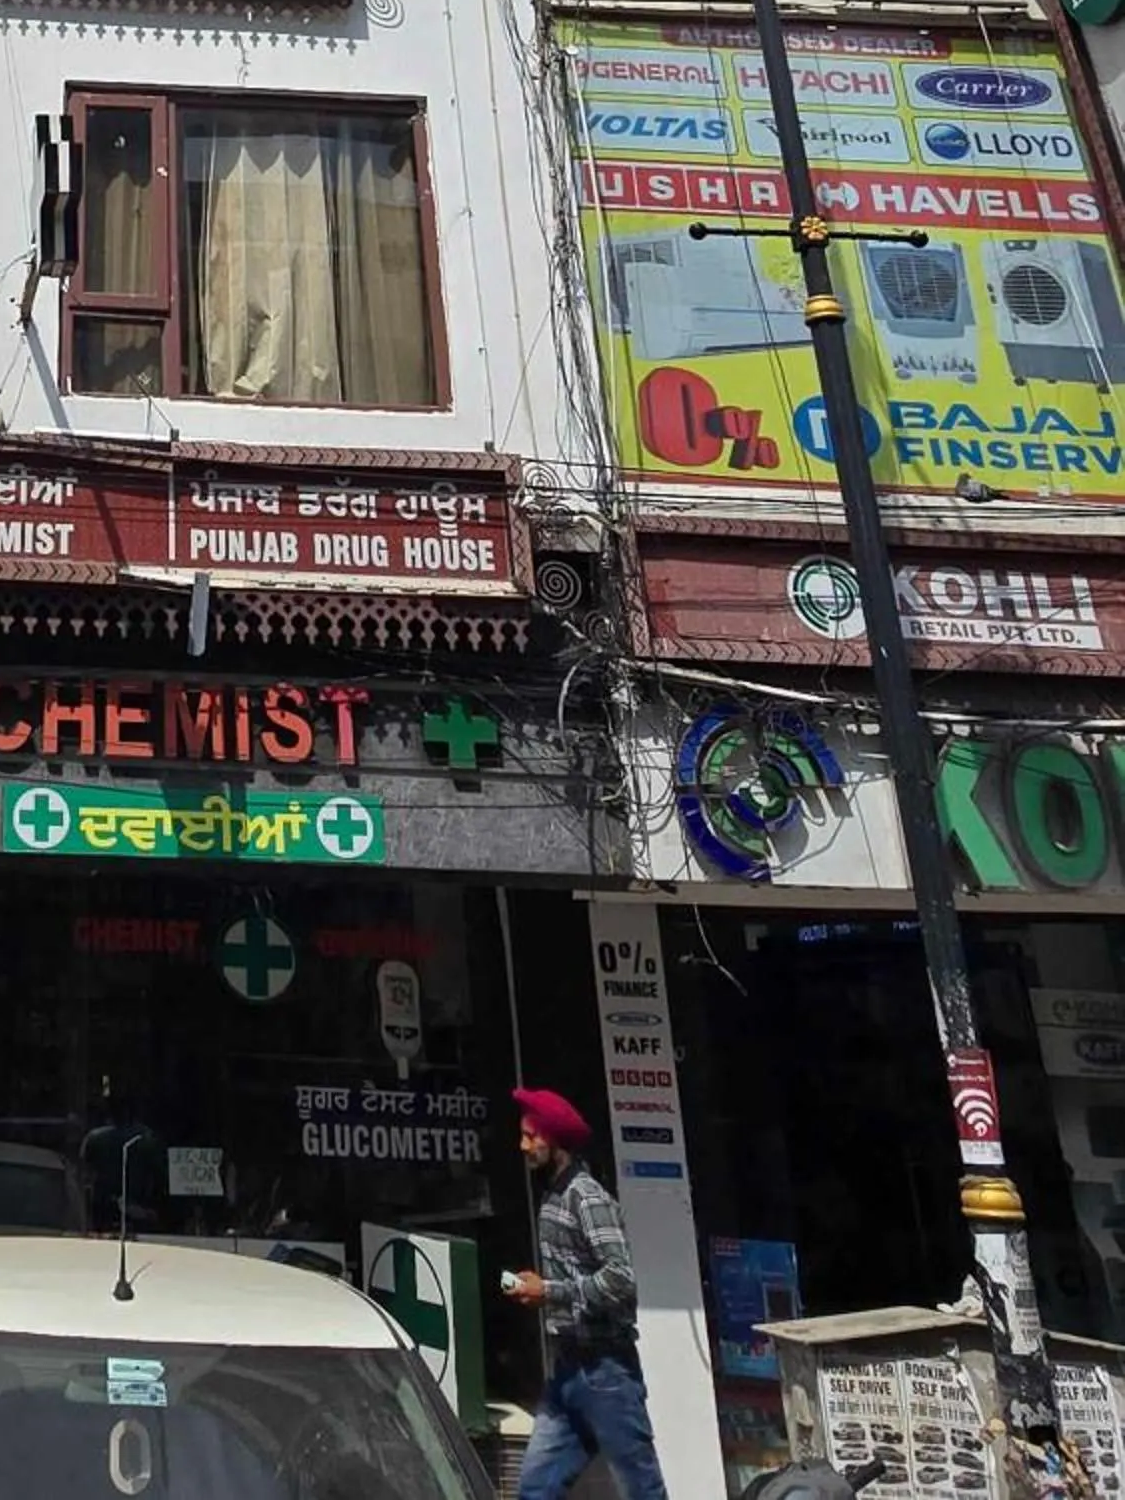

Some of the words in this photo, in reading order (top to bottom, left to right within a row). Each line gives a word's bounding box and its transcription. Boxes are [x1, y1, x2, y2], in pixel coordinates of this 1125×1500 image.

[842, 35, 938, 56] DEALER
[936, 75, 1034, 98] Carrier
[580, 112, 728, 141] VOLTAS
[975, 132, 1074, 158] LLOYD
[598, 171, 780, 207] USHA
[871, 183, 1101, 223] HAVELLS
[888, 401, 1117, 439] BAJAJ
[893, 436, 1124, 475] FINSERV
[189, 471, 282, 515] ਪੰਜਾਬ
[190, 528, 299, 564] PUNJAB
[313, 533, 389, 568] DRUG
[403, 536, 496, 572] HOUSE
[889, 563, 1097, 622] KOHLI
[910, 620, 982, 639] RETAIL
[988, 624, 1032, 641] PVT.
[1038, 630, 1082, 645] LTD.
[597, 941, 657, 975] 0%
[603, 980, 659, 999] FINANCE
[613, 1036, 662, 1056] KAFF
[301, 1120, 483, 1163] GLUCOMETER
[830, 1378, 855, 1394] SELF
[859, 1380, 892, 1396] DRIVE
[912, 1381, 937, 1397] SELF
